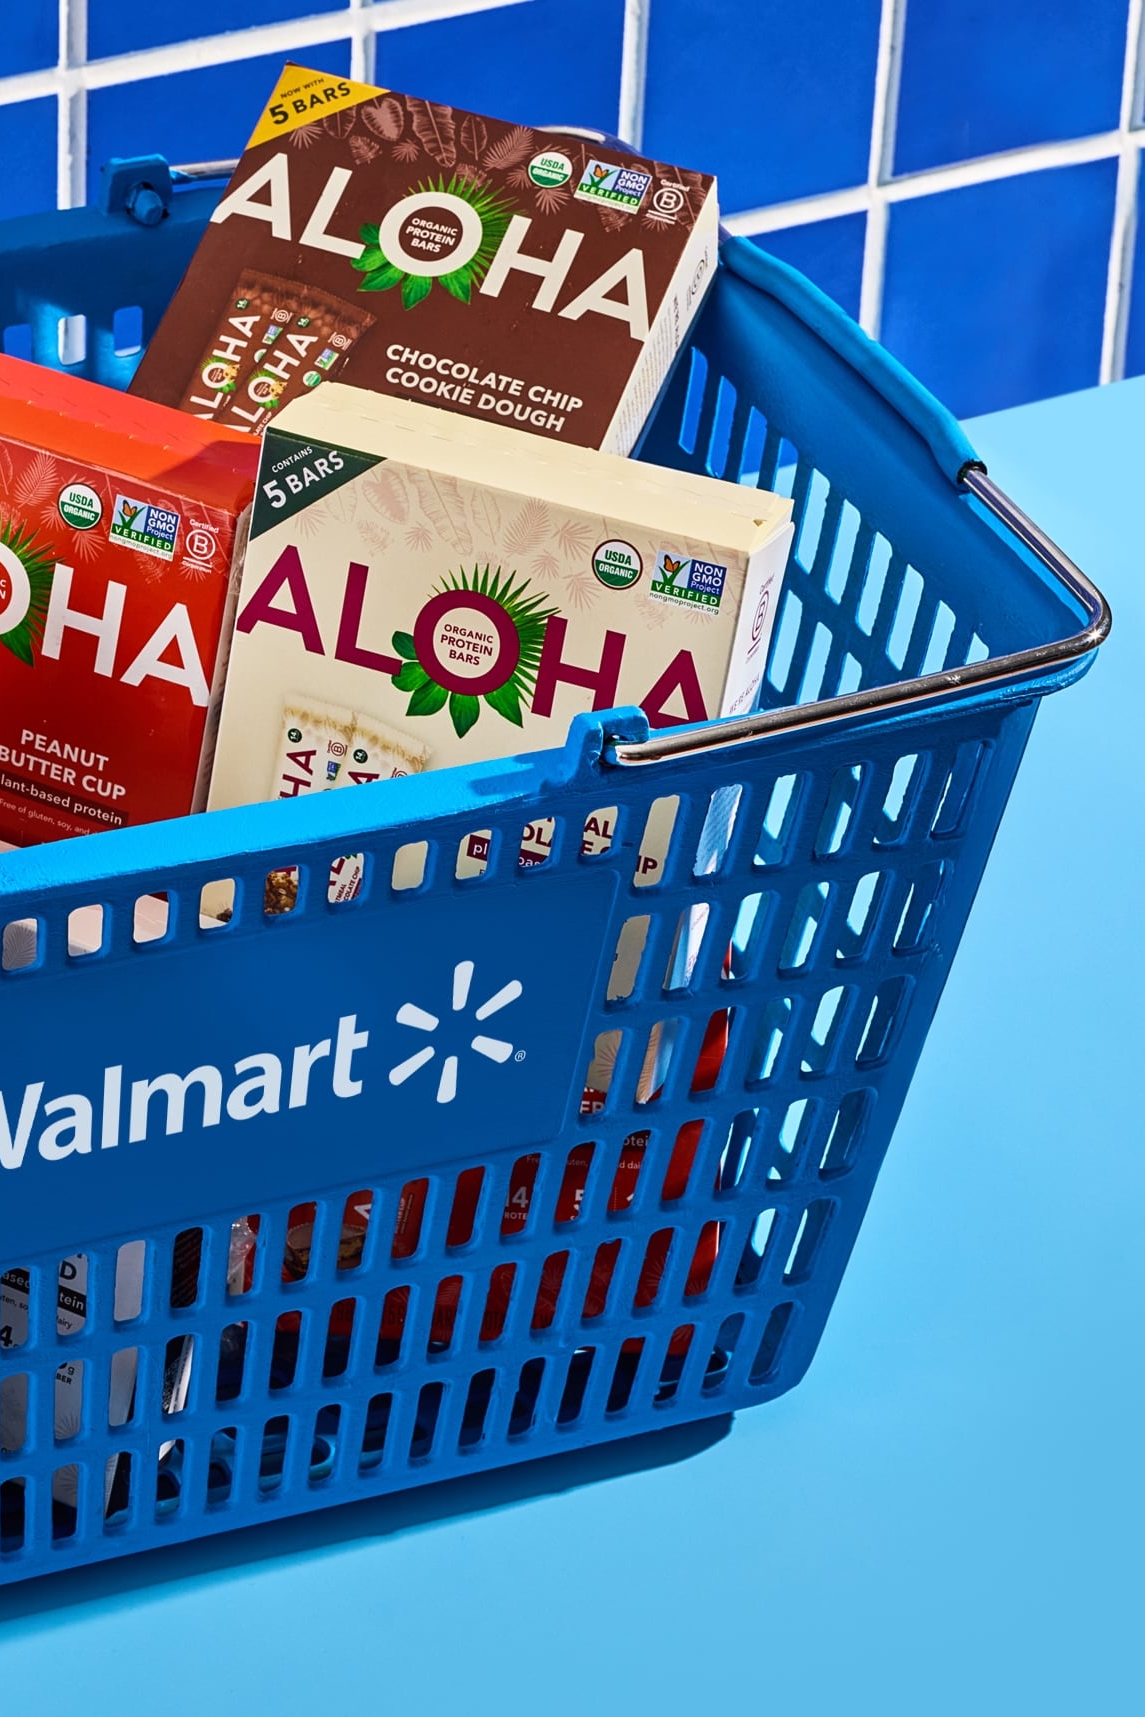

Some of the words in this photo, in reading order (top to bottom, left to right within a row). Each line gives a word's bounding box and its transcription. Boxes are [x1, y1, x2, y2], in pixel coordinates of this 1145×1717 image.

[281, 87, 301, 99] NOW
[303, 78, 325, 90] WITH
[269, 104, 289, 124] 5
[292, 82, 350, 113] BARS
[541, 158, 565, 171] USDA
[618, 179, 644, 191] GMO
[620, 171, 648, 184] NON
[582, 184, 638, 205] VERIFIED
[406, 226, 455, 246] PROTEIN
[412, 218, 458, 235] ORGANIC
[210, 152, 650, 342] ALOHA
[411, 238, 441, 253] BARS
[386, 344, 525, 396] CHOCOLATE
[528, 386, 583, 412] CHIP
[385, 367, 475, 405] COOKIE
[477, 393, 565, 432] DOUGH
[271, 446, 313, 473] CONTAINS
[263, 480, 286, 508] 5
[285, 450, 344, 494] BARS
[70, 492, 93, 508] USDA
[63, 504, 95, 521] ORGANIC
[150, 508, 176, 524] NON
[146, 526, 173, 541] Project
[148, 518, 175, 532] GMO
[189, 519, 219, 534] Certified
[115, 526, 172, 550] VERIFIED
[193, 535, 208, 554] B
[605, 550, 632, 566] USDA
[599, 563, 633, 579] ORGANIC
[692, 572, 722, 587] GMO
[694, 563, 722, 577] NON
[655, 582, 718, 605] VERIFIED
[691, 581, 720, 594] Project
[649, 592, 719, 615] nongmoproject.org
[236, 543, 707, 729] ALOHA
[444, 624, 493, 643] ORGANIC
[440, 634, 493, 656] PROTEIN
[449, 649, 480, 665] BARS
[20, 729, 109, 772] PEANUT
[82, 775, 127, 800] CUP
[17, 805, 27, 814] of
[28, 809, 55, 826] gluten,
[57, 820, 73, 832] soy,
[75, 824, 90, 836] and
[74, 801, 123, 826] protein
